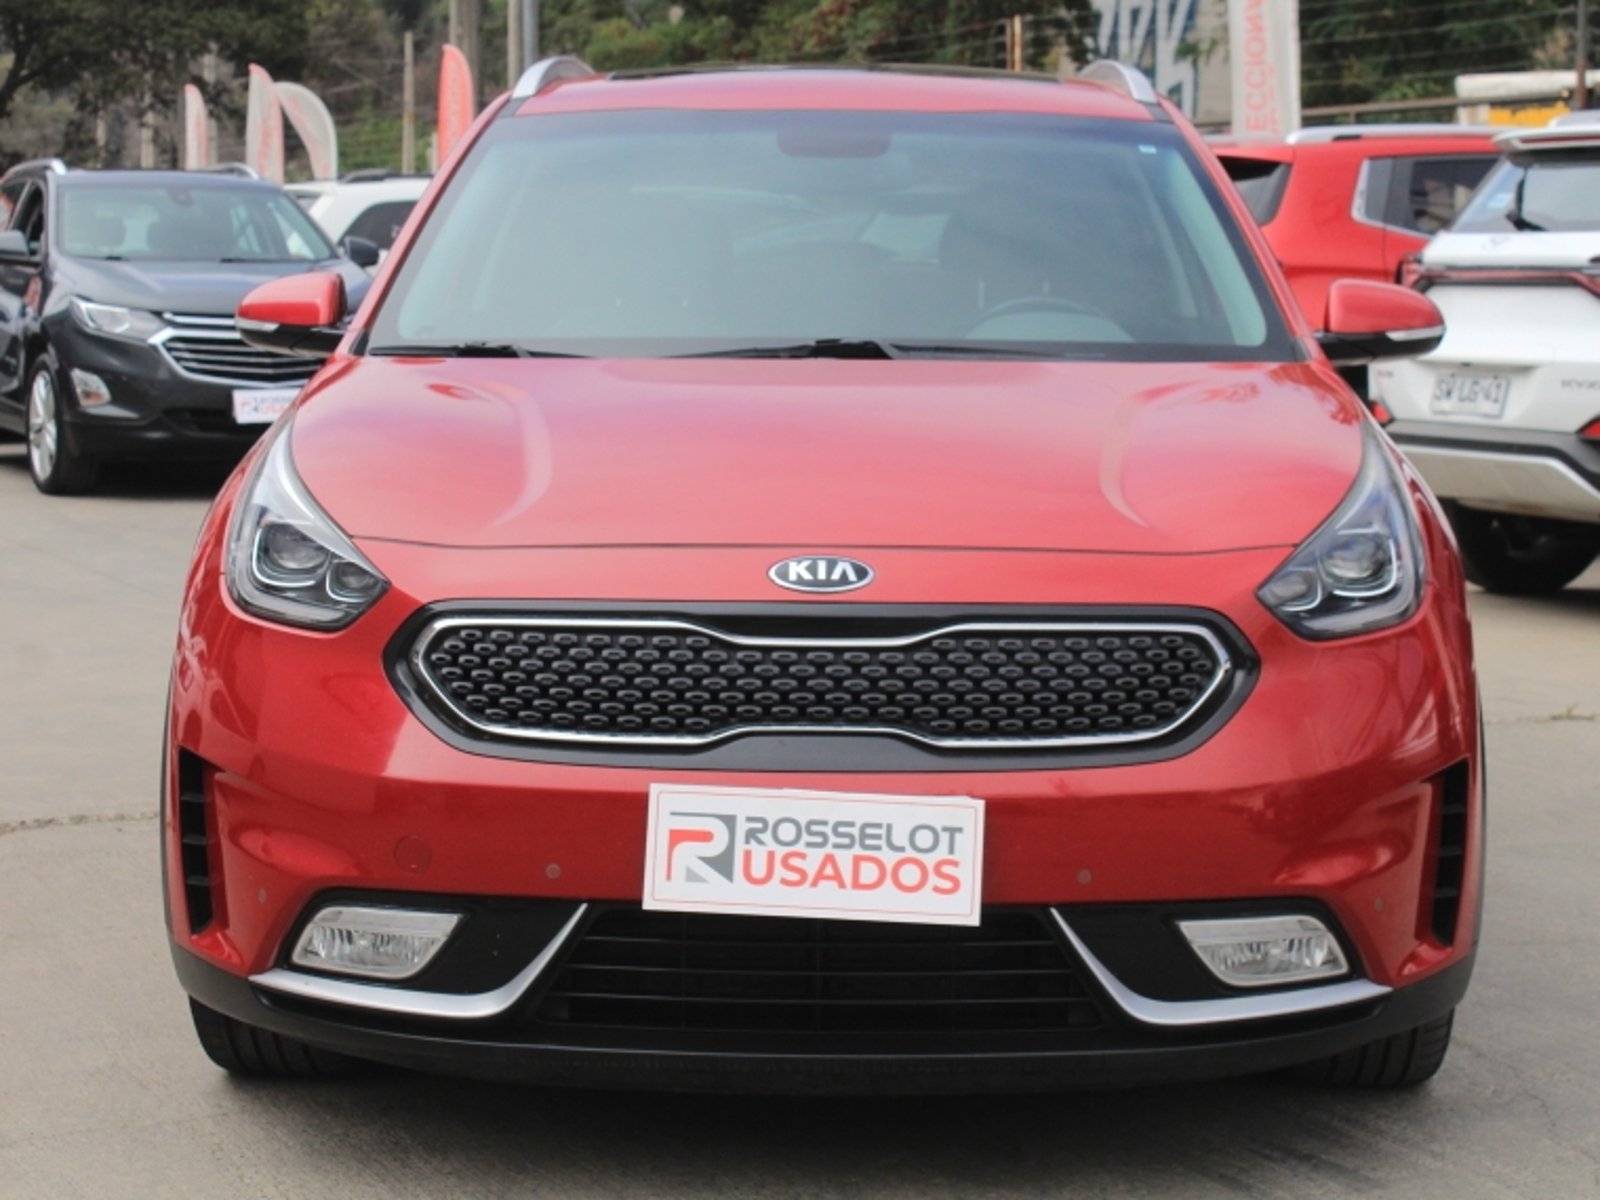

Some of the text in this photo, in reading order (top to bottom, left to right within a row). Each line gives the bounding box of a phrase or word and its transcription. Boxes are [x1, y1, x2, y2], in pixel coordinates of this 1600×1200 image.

[788, 559, 858, 582] KIA
[744, 816, 964, 855] ROSSELOT
[742, 849, 962, 896] USADOS
